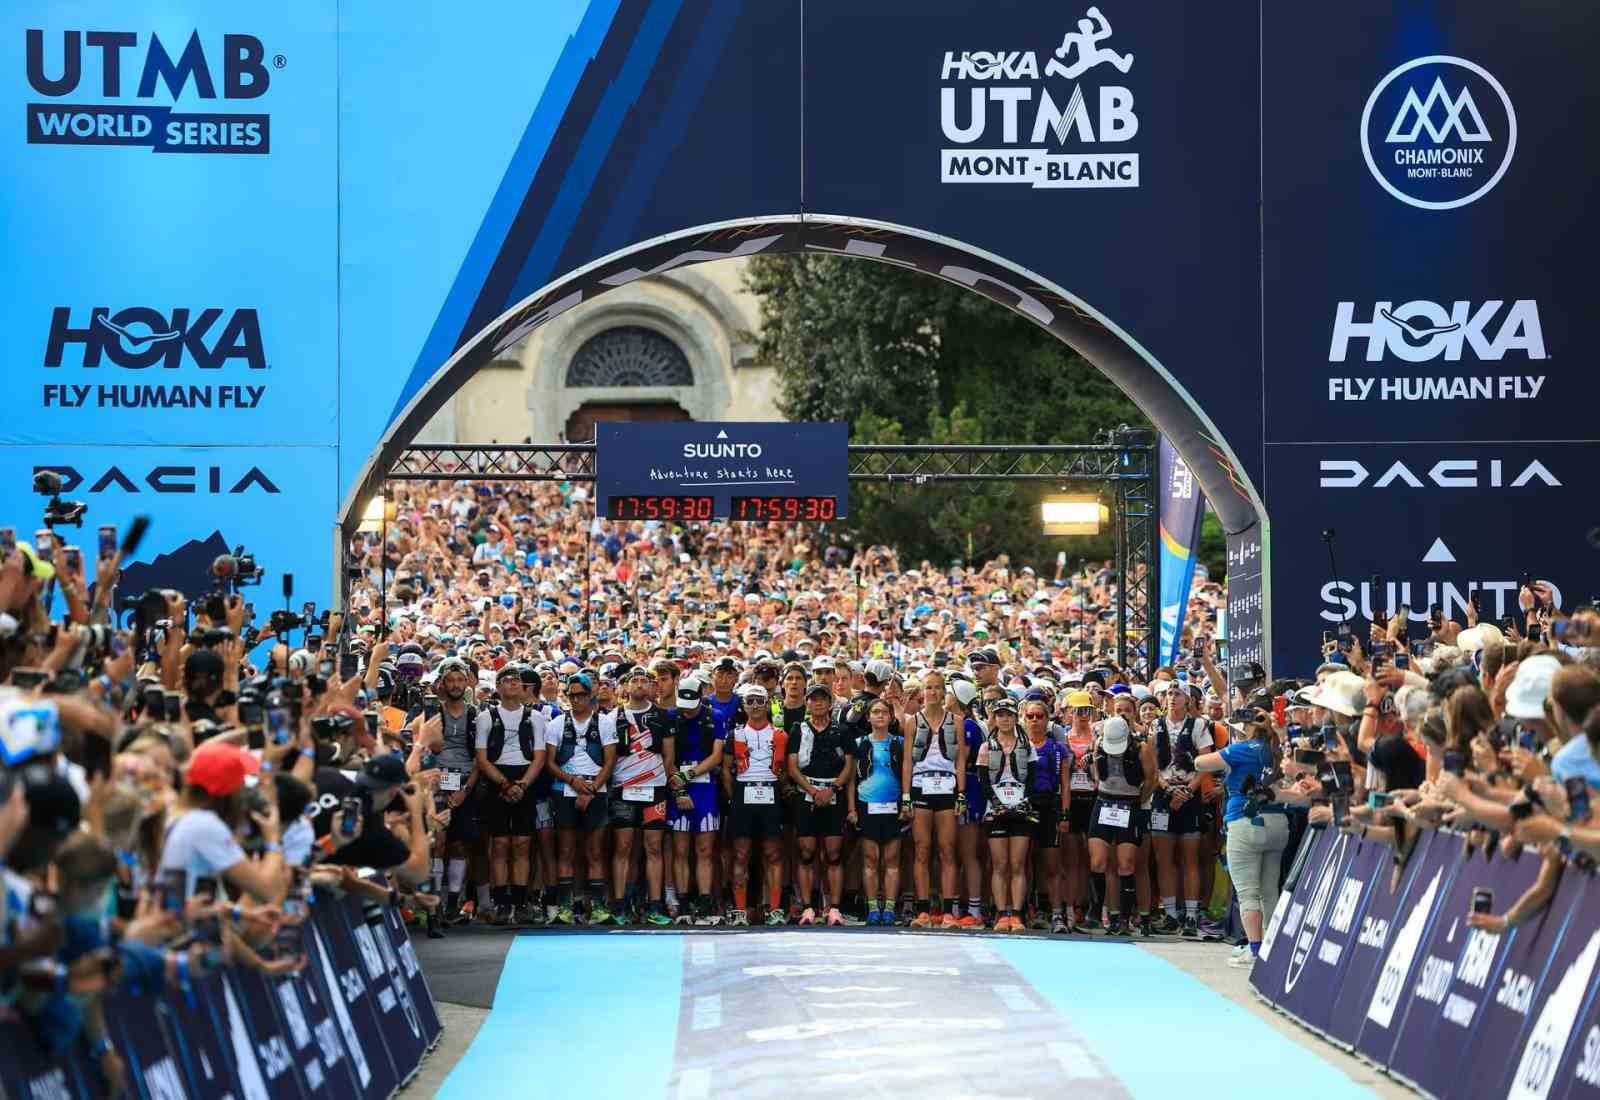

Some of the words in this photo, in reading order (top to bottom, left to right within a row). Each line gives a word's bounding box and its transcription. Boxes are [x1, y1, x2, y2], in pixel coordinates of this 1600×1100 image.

[941, 51, 1040, 80] HOKA
[940, 82, 1139, 147] UTMB
[37, 112, 152, 138] WORLD
[165, 122, 262, 147] SERIES
[1394, 148, 1484, 165] CHAMONIX
[1407, 167, 1473, 178] MONT-BLANC
[44, 306, 267, 370] HOKA
[1328, 299, 1547, 362] HOKA
[43, 384, 92, 408] FLY
[99, 384, 212, 409] HUMAN
[218, 385, 266, 409] FLY
[1328, 378, 1375, 401] FLY
[1380, 377, 1493, 401] HUMAN
[1499, 376, 1546, 399] FLY
[683, 443, 762, 458] SUUNTO
[33, 466, 281, 494] DACIA
[1320, 458, 1563, 487] DACIA
[616, 498, 712, 518] 17:59:30
[739, 498, 835, 518] 17:59:30
